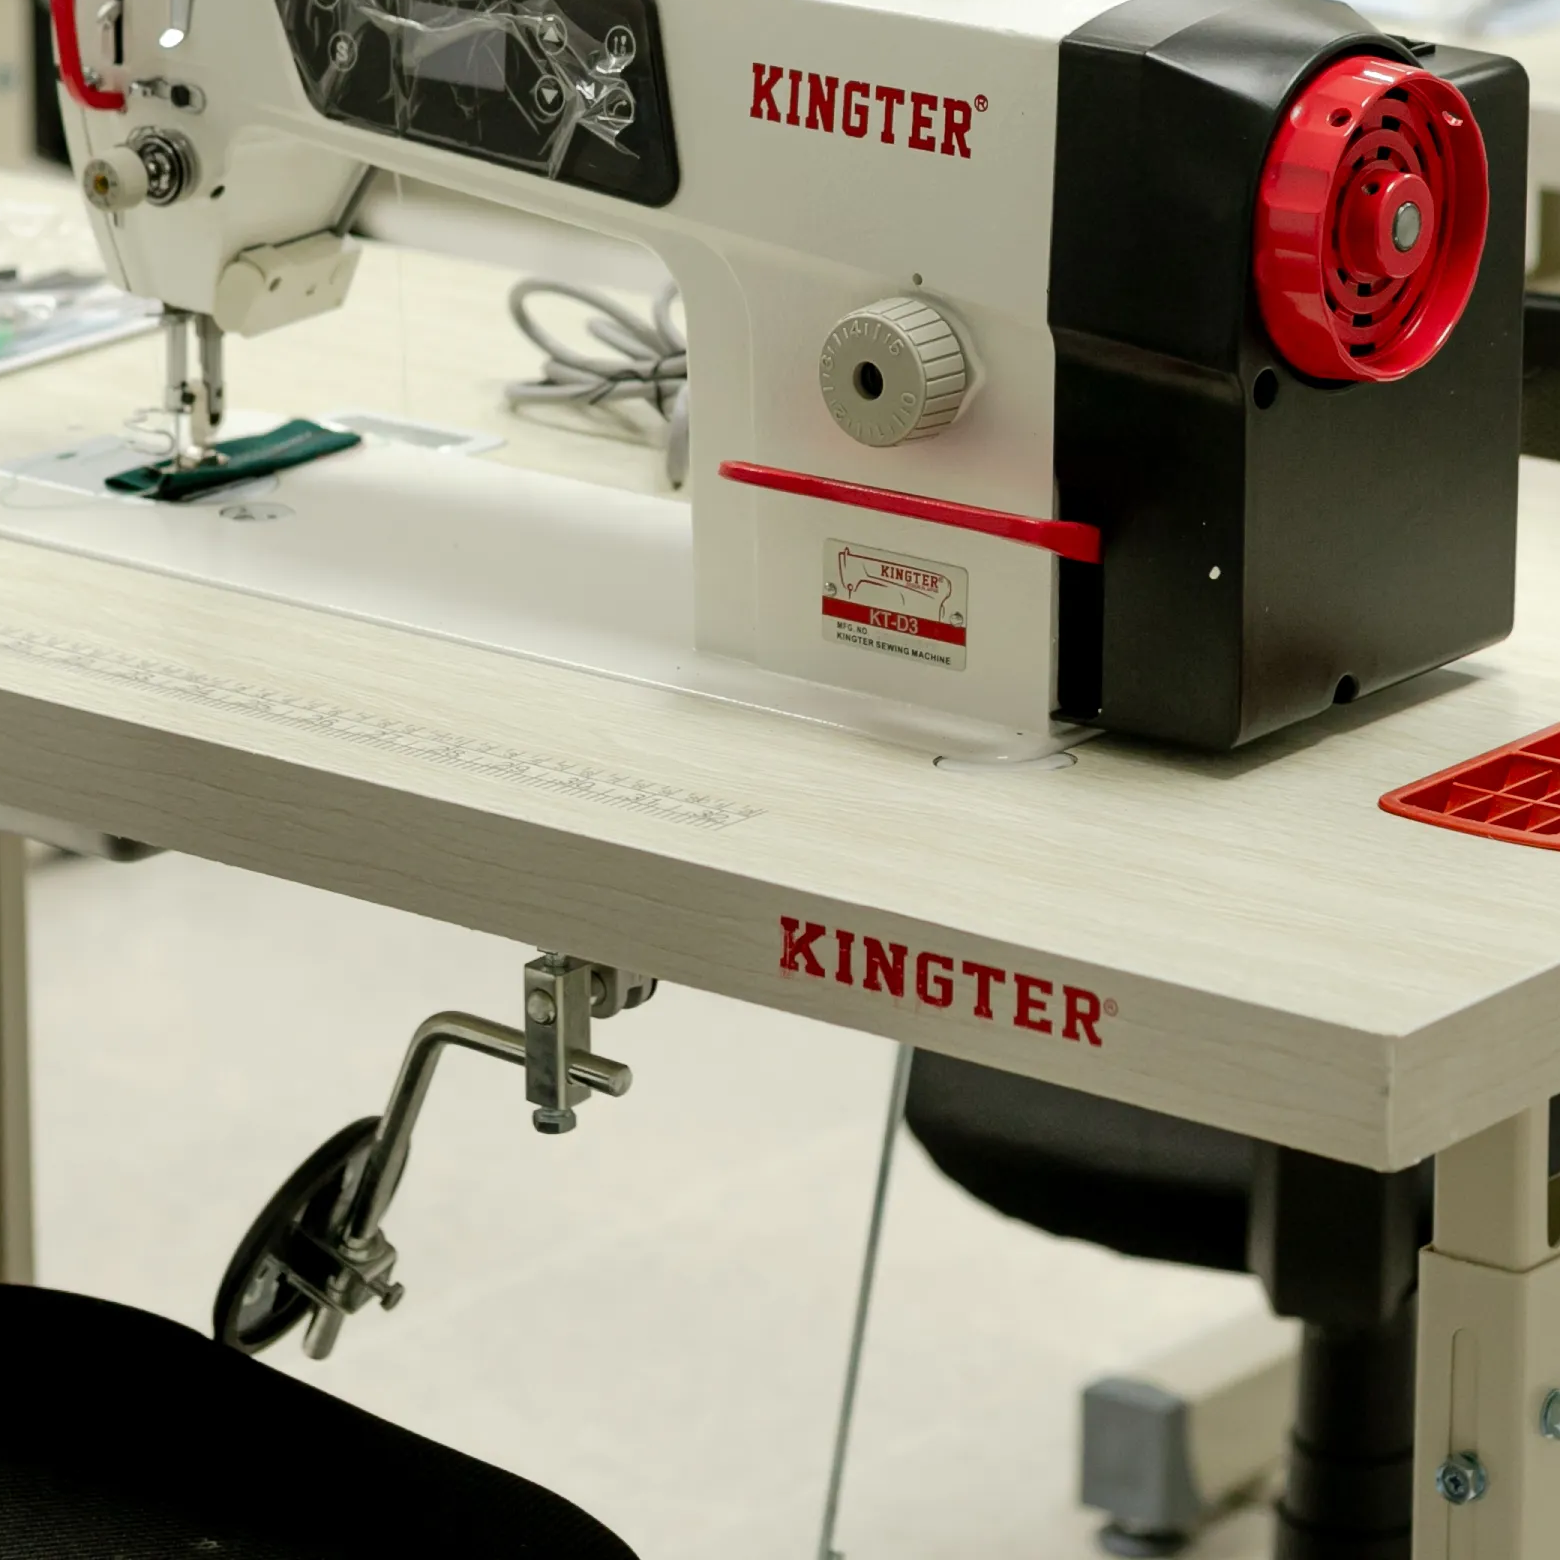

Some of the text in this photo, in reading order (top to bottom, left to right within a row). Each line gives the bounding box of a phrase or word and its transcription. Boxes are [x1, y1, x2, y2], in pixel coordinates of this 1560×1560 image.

[869, 608, 919, 635] KT-D3
[837, 632, 951, 665] KINGTER SEWING MACHINE
